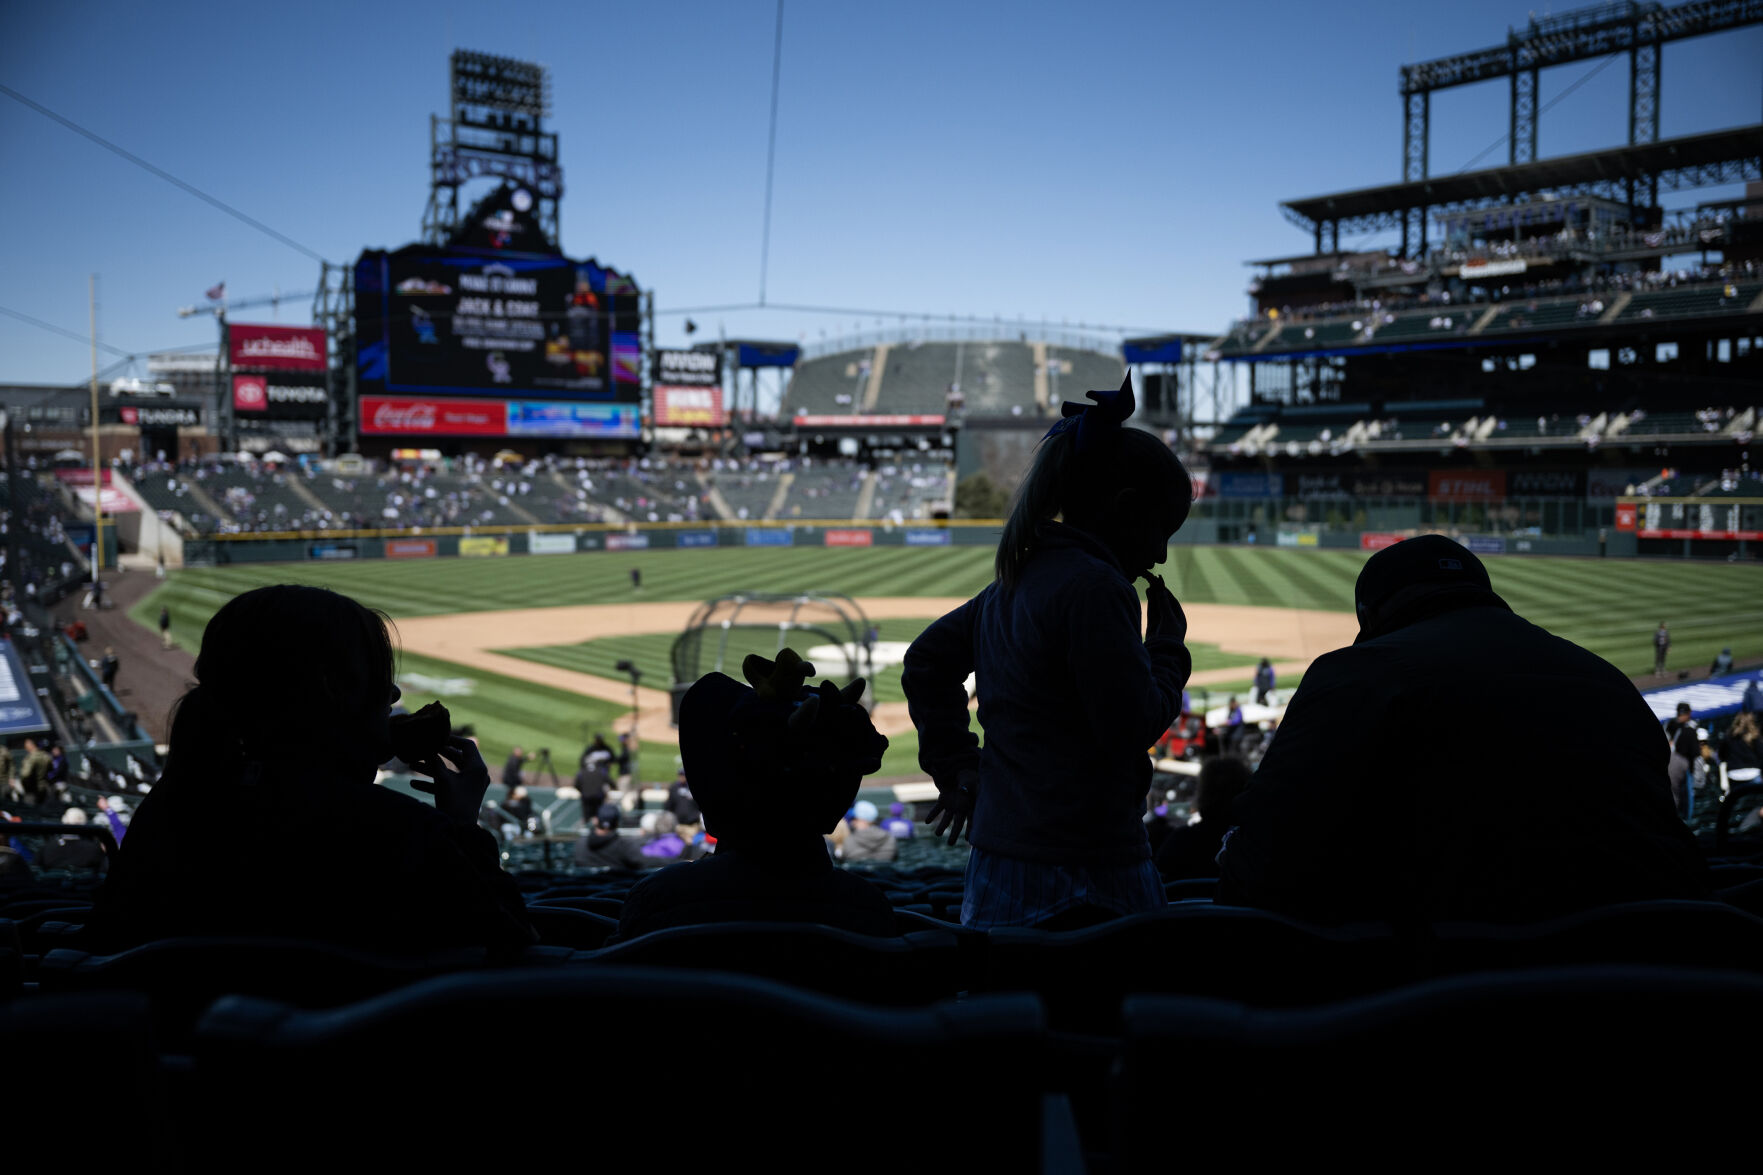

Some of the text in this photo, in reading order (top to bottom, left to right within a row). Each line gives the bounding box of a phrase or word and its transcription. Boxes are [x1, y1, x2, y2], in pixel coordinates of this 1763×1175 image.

[242, 335, 315, 357] uchealth
[267, 385, 327, 403] TOYOTA
[138, 408, 197, 425] TUNDRA
[1437, 478, 1496, 496] STIHL
